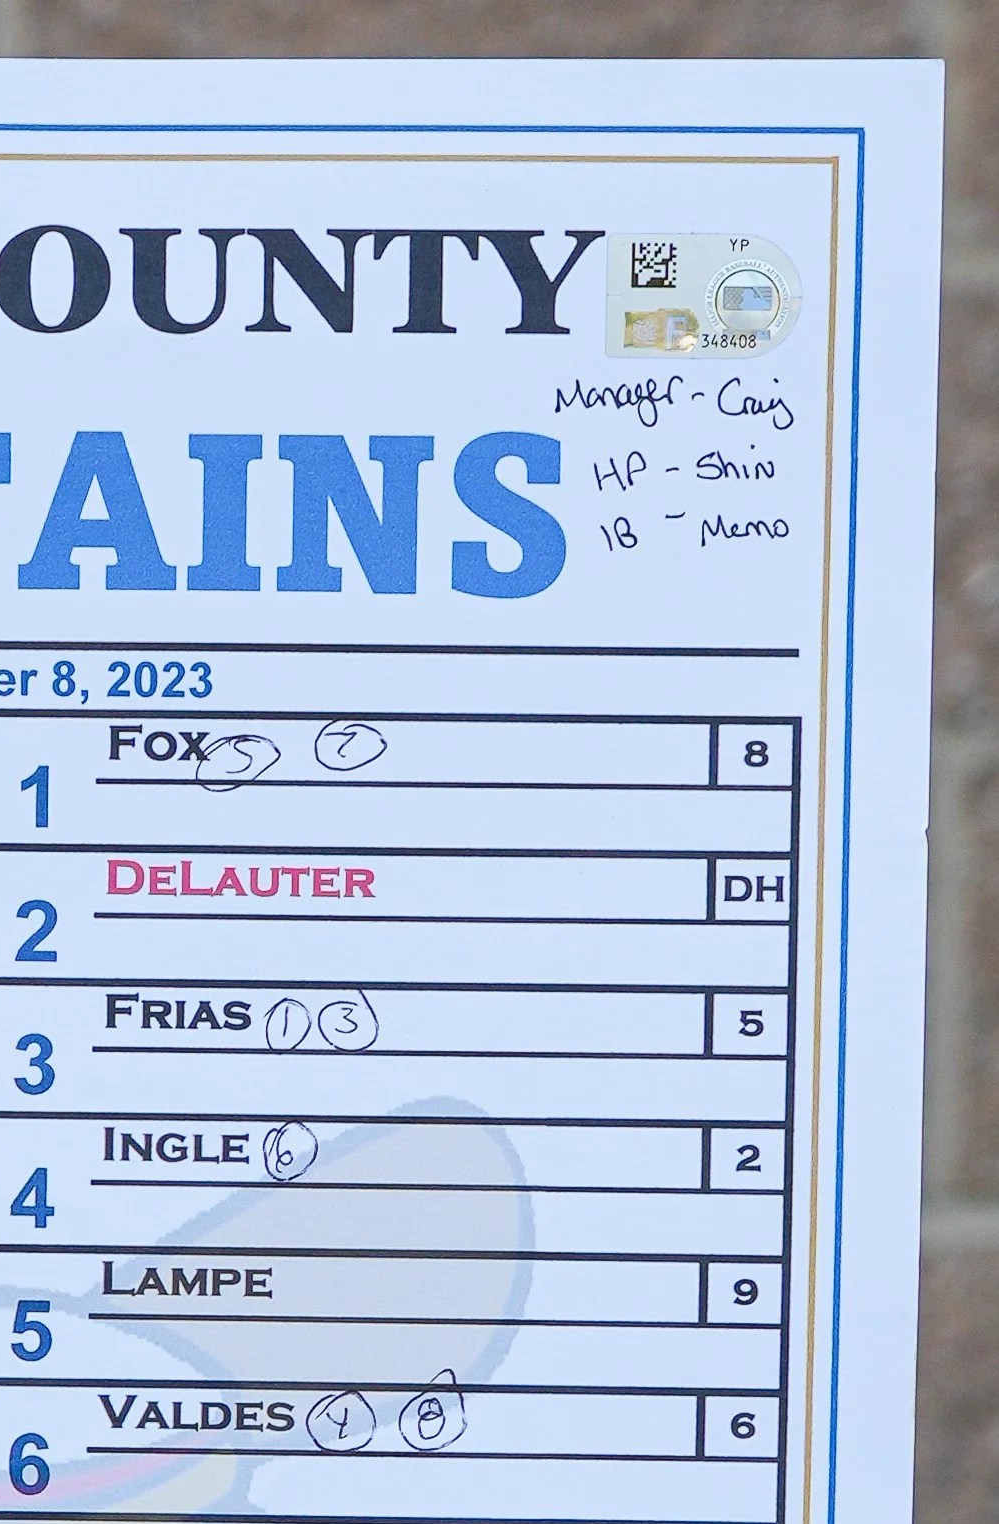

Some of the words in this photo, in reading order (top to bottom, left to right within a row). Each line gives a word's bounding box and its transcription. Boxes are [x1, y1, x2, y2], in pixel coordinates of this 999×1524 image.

[729, 238, 750, 252] YP
[702, 335, 756, 348] 348408
[555, 376, 683, 427] Manager
[718, 377, 793, 430] Craig
[594, 451, 646, 491] HP
[702, 515, 788, 547] Memo
[51, 660, 89, 705] 8,
[106, 660, 213, 699] 2023
[109, 724, 214, 764] FOX
[743, 740, 769, 768] 8
[20, 765, 50, 828] 1
[723, 875, 785, 903] DH
[14, 899, 58, 963] 2
[105, 992, 252, 1031] FRIAS
[738, 1009, 764, 1037] 5
[13, 1033, 56, 1096] 3
[103, 1126, 250, 1165] INGLE
[735, 1144, 762, 1173] 2
[10, 1167, 55, 1229] 4
[102, 1260, 273, 1299] LAMPE
[733, 1278, 759, 1306] 9
[10, 1299, 53, 1362] 5
[98, 1394, 295, 1433] VALDES
[730, 1412, 756, 1440] 6
[8, 1432, 51, 1496] 6
